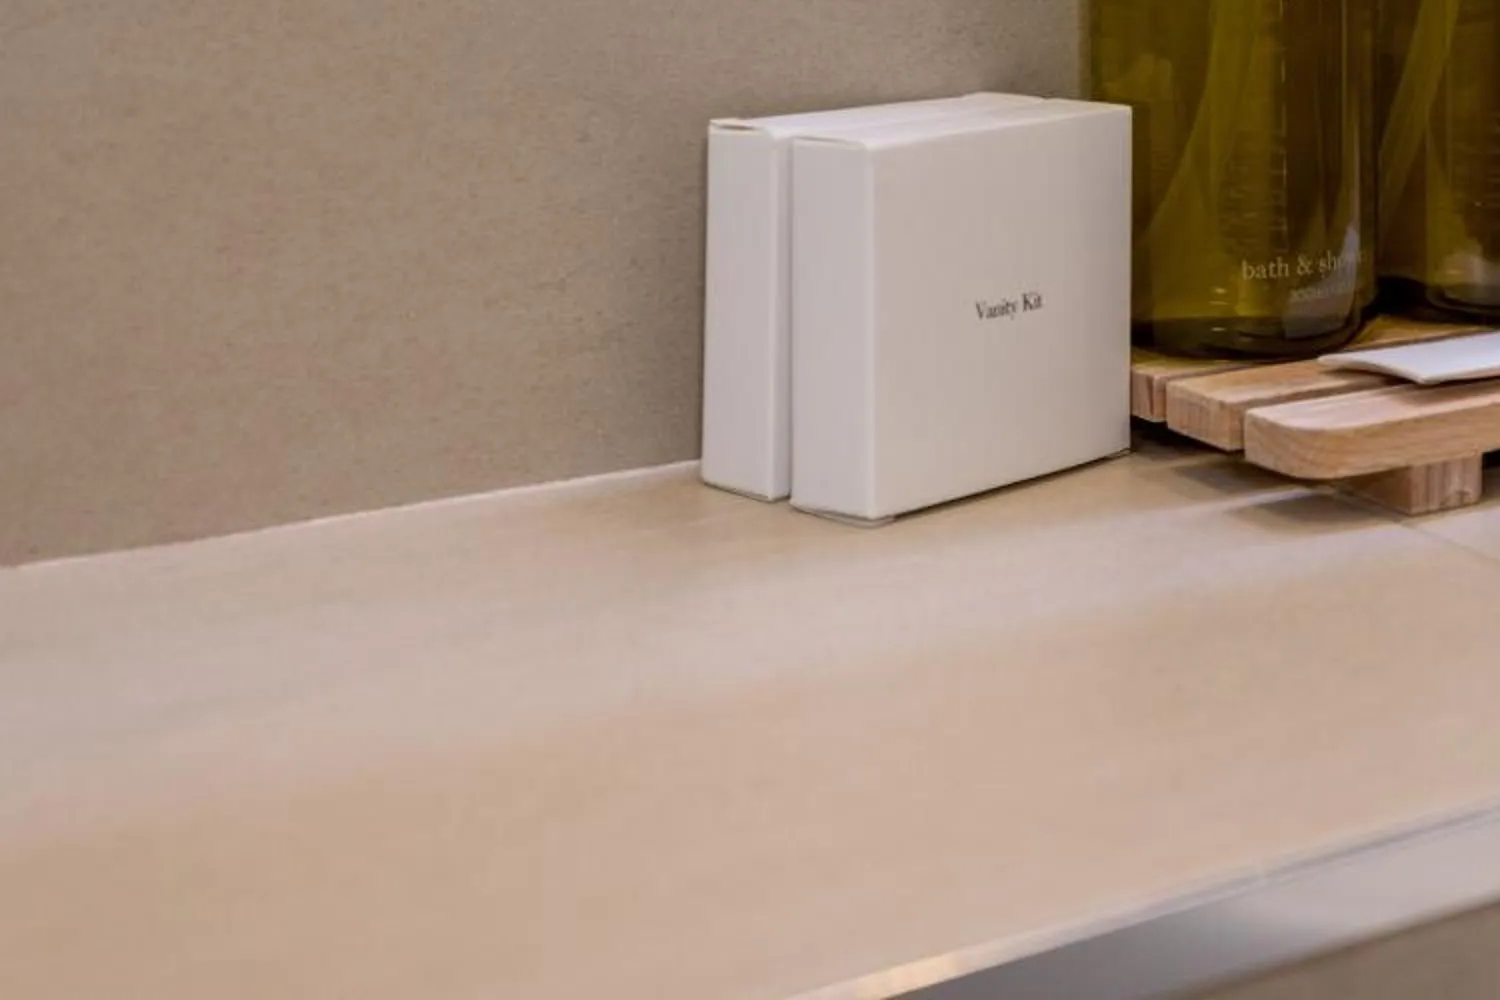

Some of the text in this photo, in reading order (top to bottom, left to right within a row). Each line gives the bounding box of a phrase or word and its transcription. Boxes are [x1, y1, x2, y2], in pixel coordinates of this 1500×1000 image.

[1241, 256, 1290, 280] bath
[1296, 253, 1314, 276] &
[975, 292, 1042, 321] Vanity Kit
